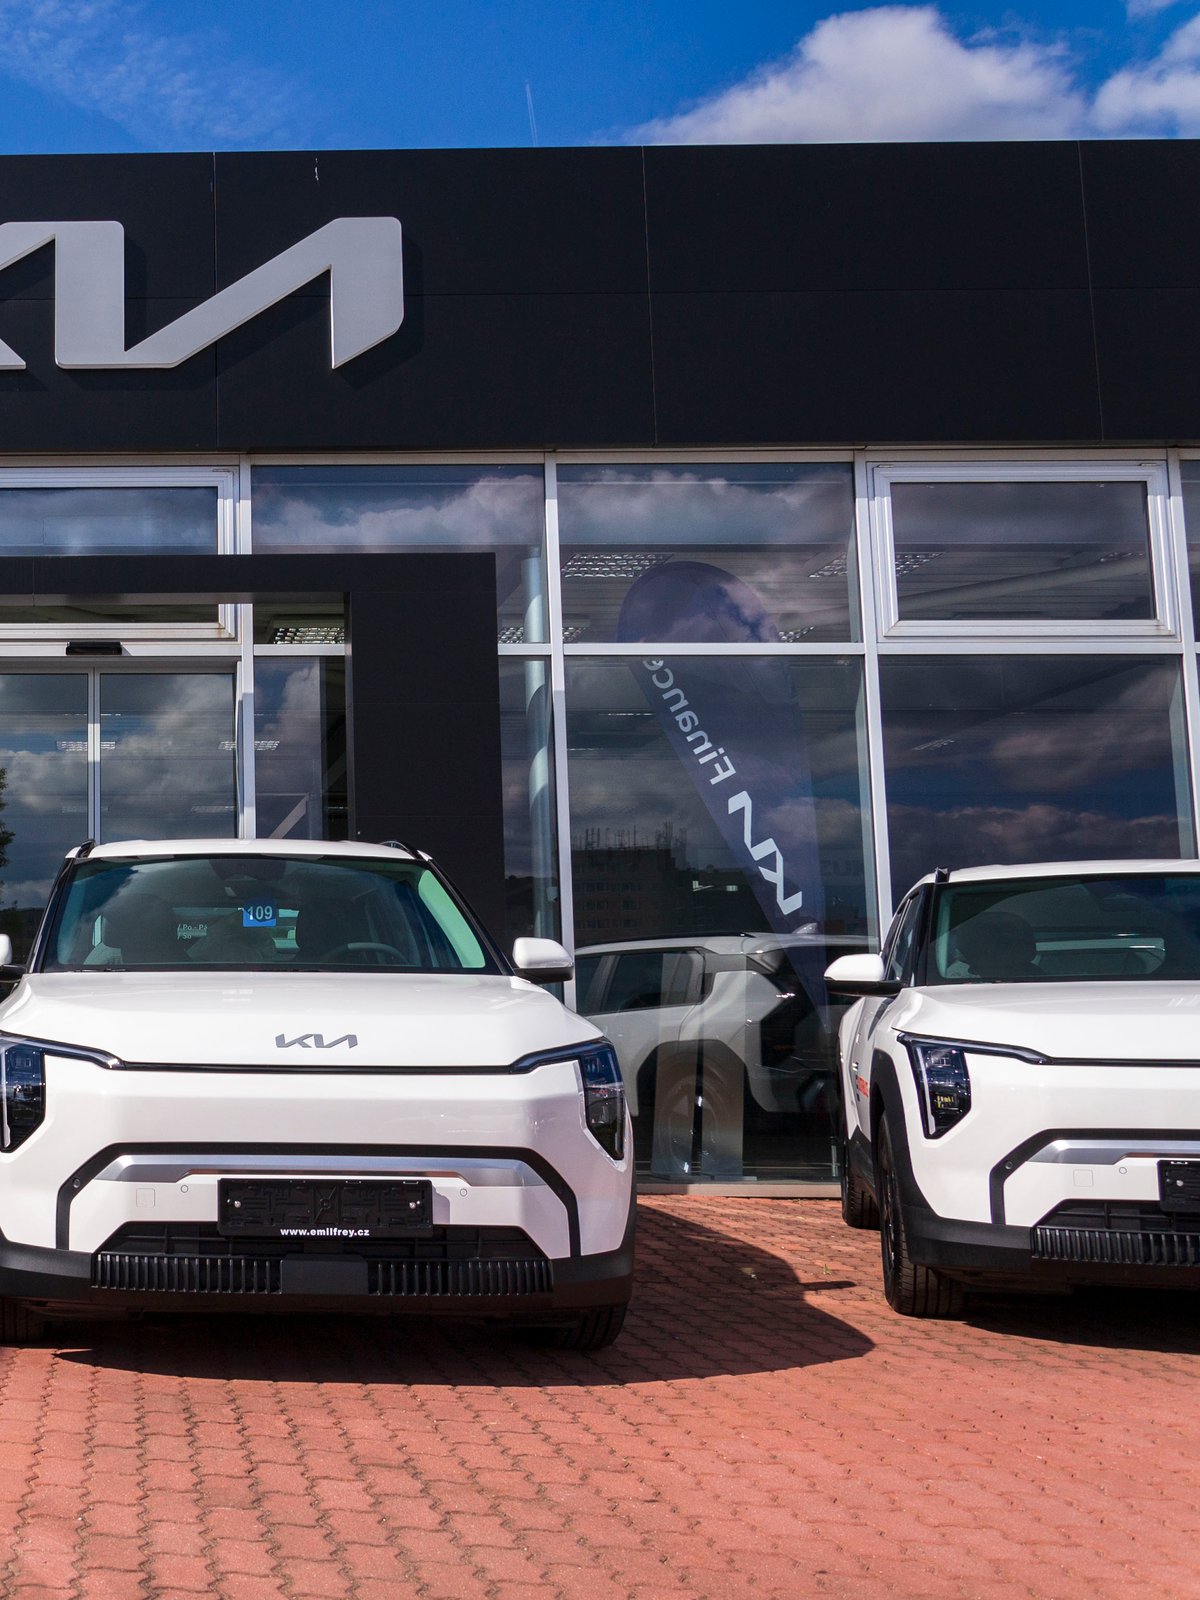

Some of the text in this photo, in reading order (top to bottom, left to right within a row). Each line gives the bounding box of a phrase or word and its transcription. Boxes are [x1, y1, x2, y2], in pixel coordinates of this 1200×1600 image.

[247, 905, 273, 920] 109
[275, 1033, 358, 1048] KIA
[280, 1227, 370, 1237] www.emilfrey.cz
